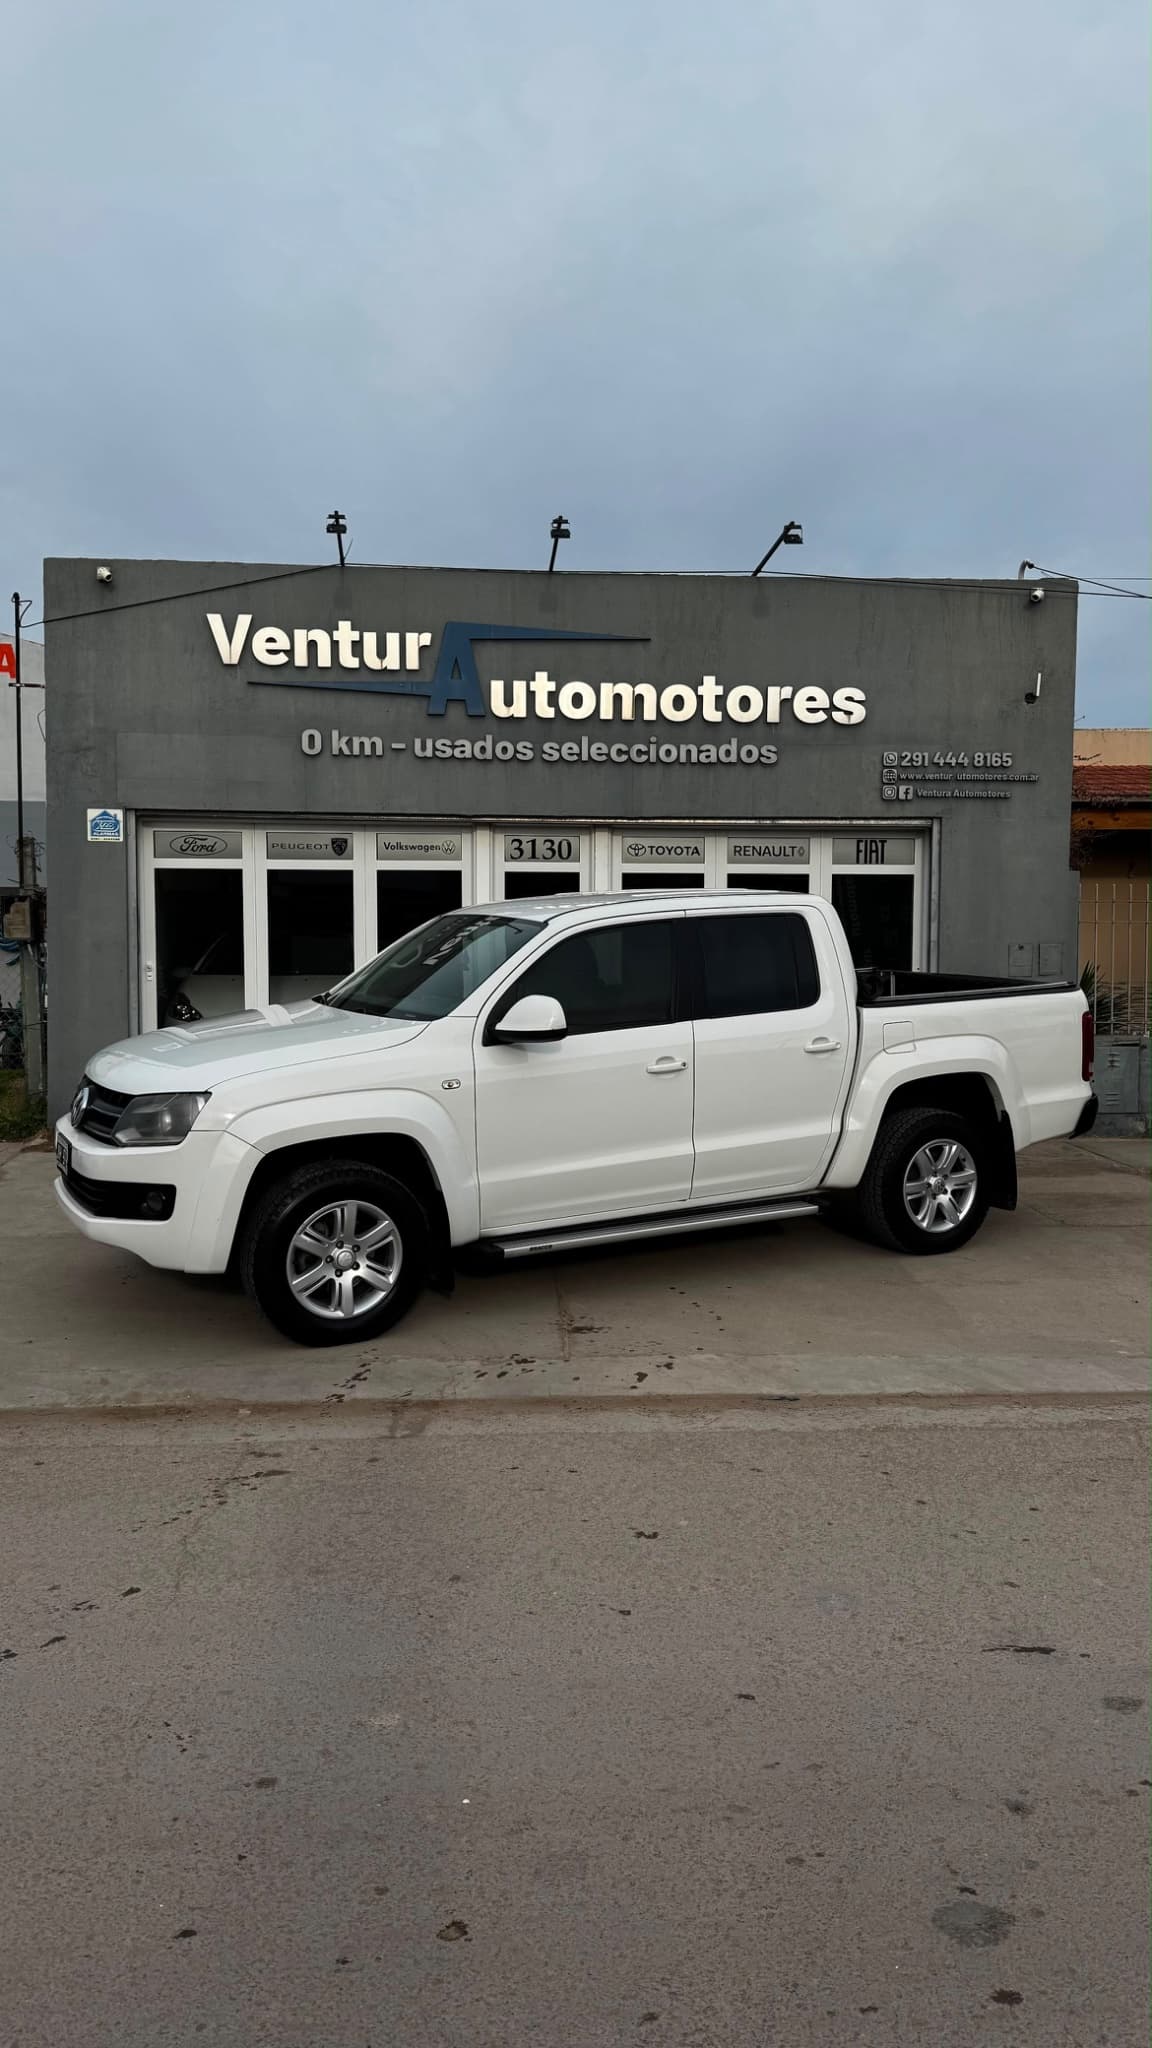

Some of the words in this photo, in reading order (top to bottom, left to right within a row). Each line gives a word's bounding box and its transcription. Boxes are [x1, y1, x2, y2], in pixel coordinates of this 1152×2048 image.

[302, 728, 322, 756] 0
[331, 729, 383, 757] km
[414, 734, 534, 761] usados
[542, 736, 779, 765] seleccionados
[901, 752, 929, 767] 291
[933, 752, 969, 767] 444
[974, 752, 1013, 767] 8165
[917, 788, 951, 797] Ventura
[953, 788, 1011, 798] Automotores
[180, 836, 218, 853] Ford
[271, 842, 329, 850] PEUGEOT
[383, 841, 441, 853] Volkswagen
[509, 838, 572, 861] 3130
[647, 845, 701, 857] TOYOTA
[733, 845, 797, 858] RENAULT
[855, 839, 888, 865] FIAT
